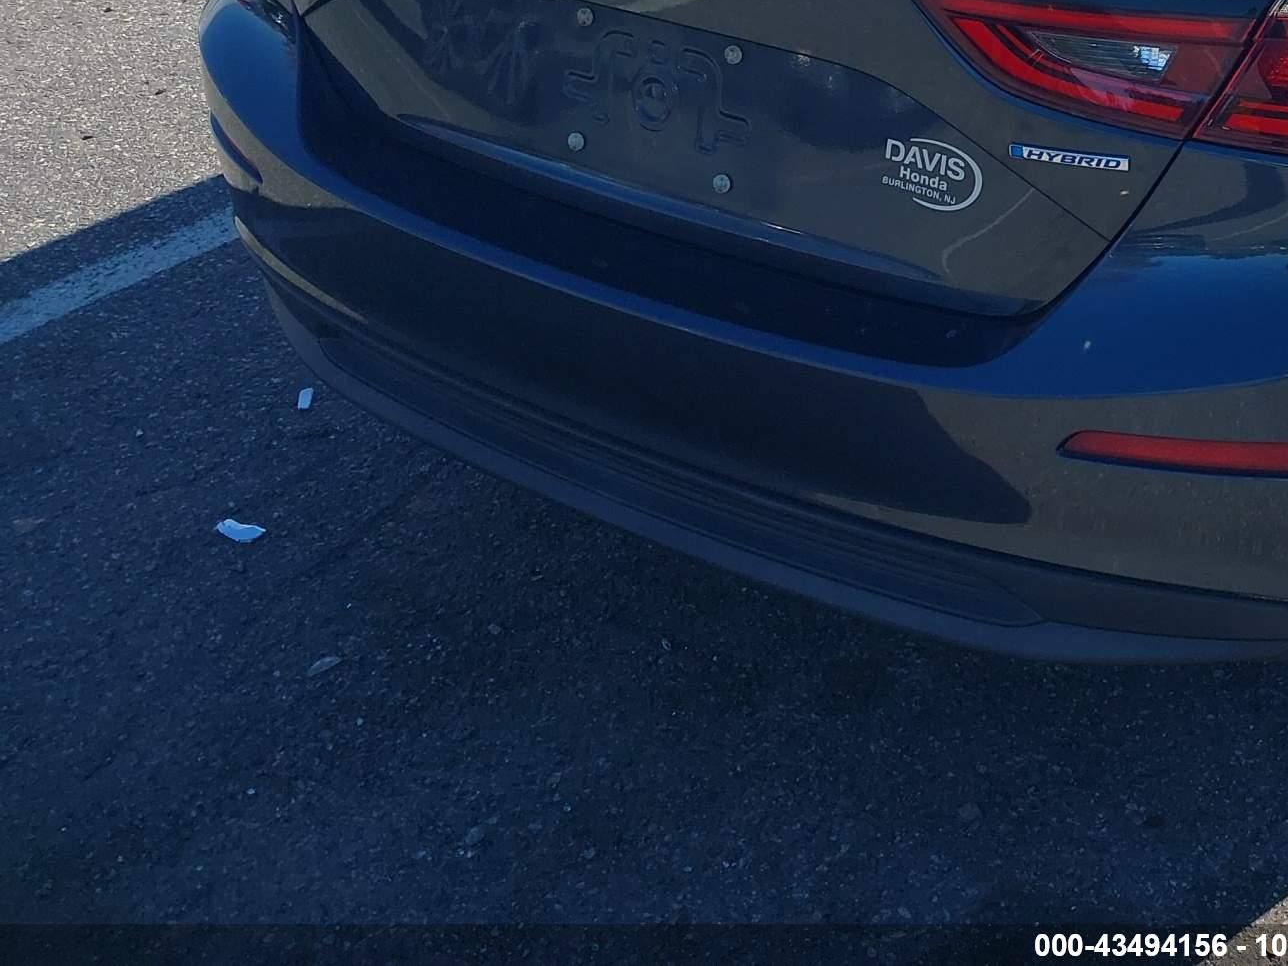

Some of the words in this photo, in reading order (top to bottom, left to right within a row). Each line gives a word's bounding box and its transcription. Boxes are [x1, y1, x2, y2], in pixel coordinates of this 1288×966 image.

[885, 138, 965, 181] DAVIS
[1025, 148, 1122, 170] HYBRID
[882, 175, 942, 202] BURLINGTON,
[944, 194, 957, 205] NJ
[899, 165, 949, 192] Honda
